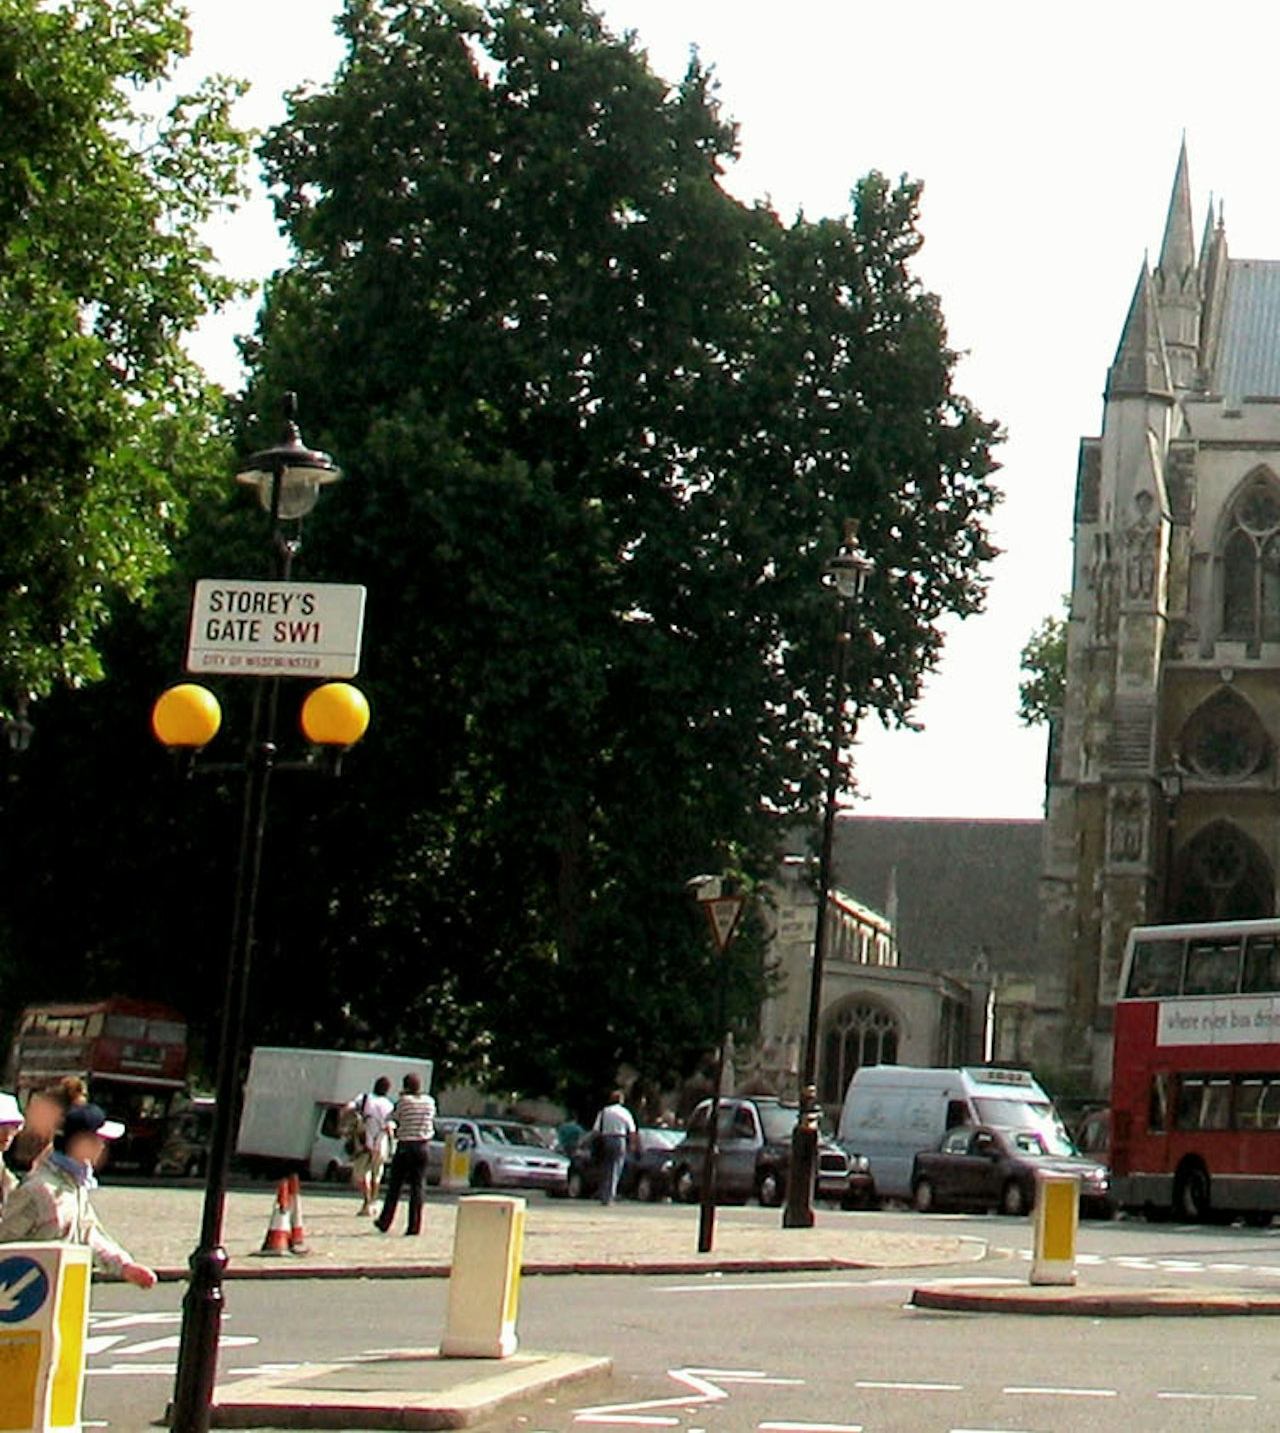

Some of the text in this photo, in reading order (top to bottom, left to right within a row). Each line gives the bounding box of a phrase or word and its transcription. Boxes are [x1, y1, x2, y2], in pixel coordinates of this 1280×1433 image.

[209, 590, 315, 615] STOREY'S
[206, 619, 320, 644] GATE SW1
[203, 654, 320, 668] CITY OF WESTMINSTER
